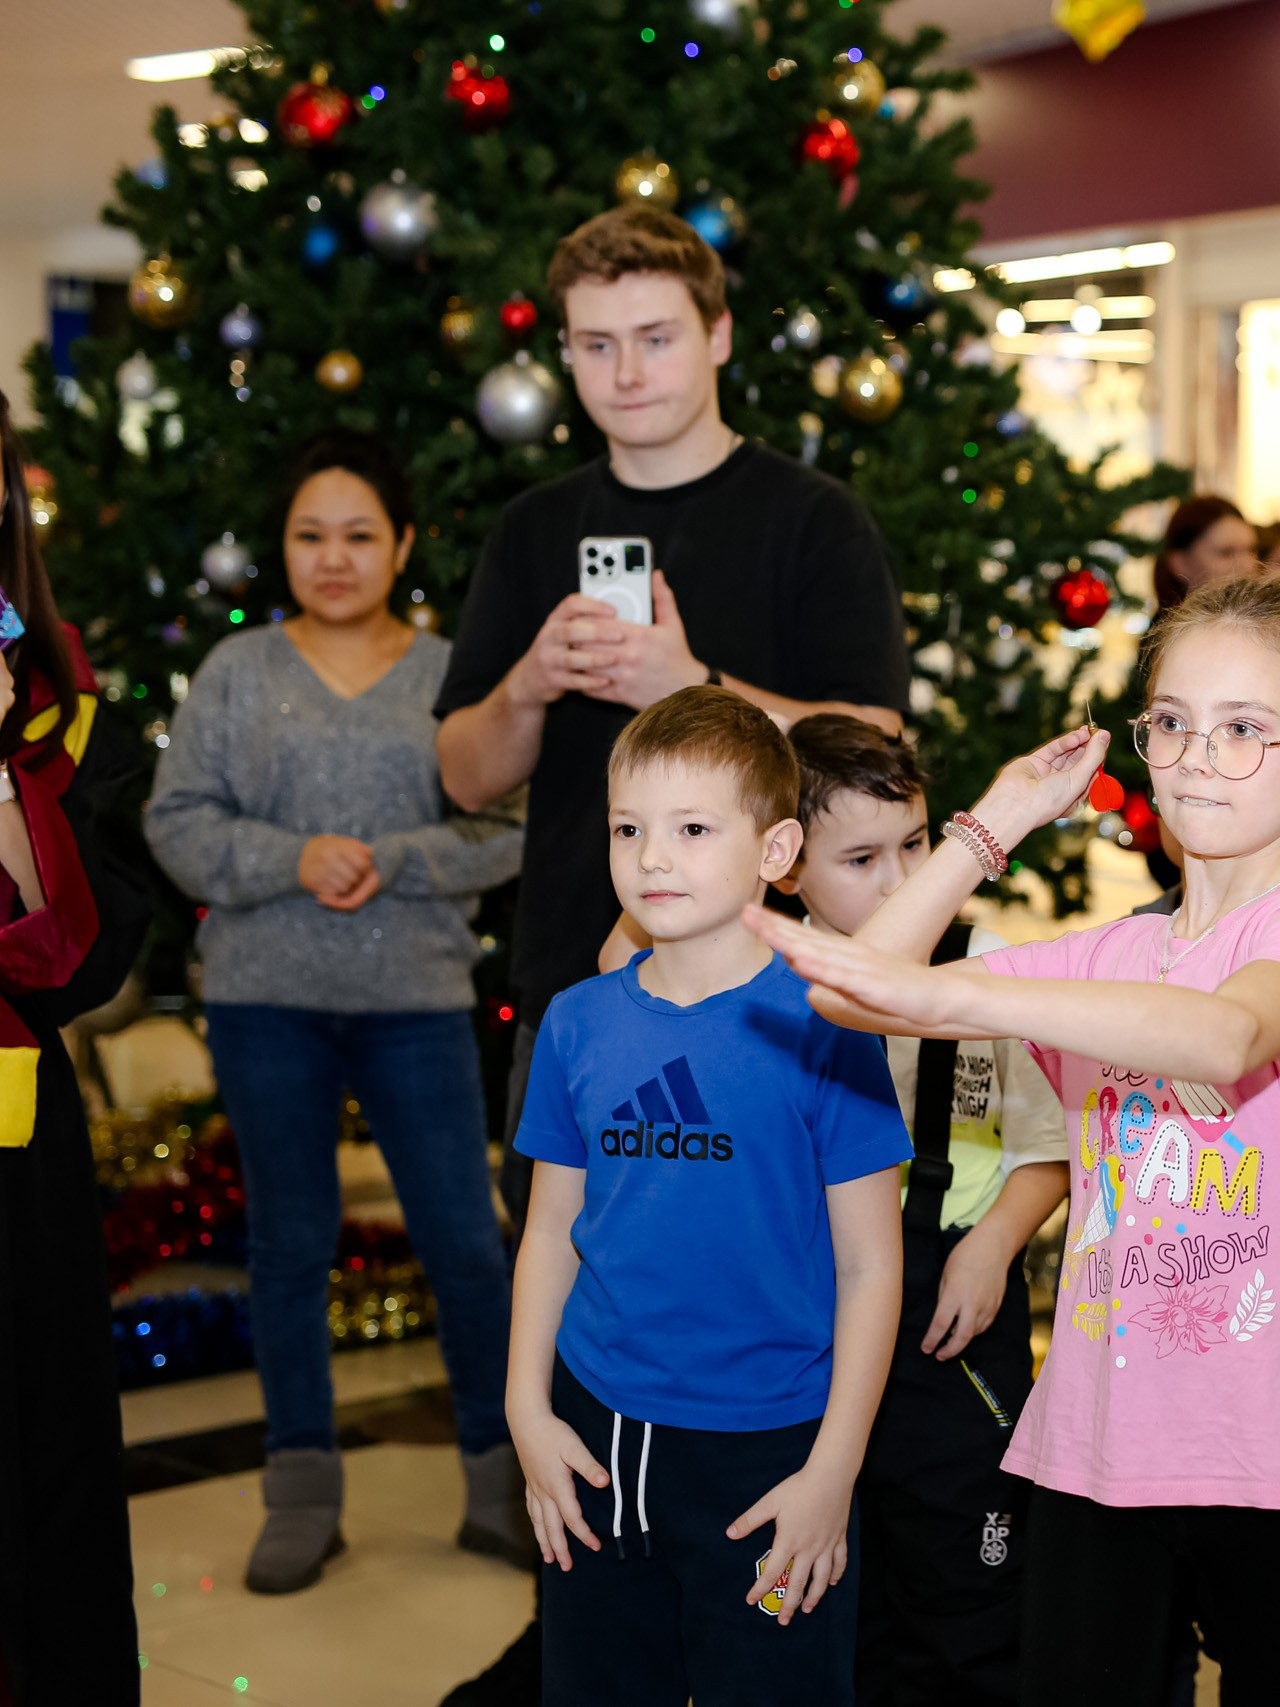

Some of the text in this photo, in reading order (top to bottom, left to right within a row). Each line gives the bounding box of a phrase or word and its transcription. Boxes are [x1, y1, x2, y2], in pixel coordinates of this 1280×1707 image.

[600, 1120, 733, 1162] adidas
[1120, 1245, 1149, 1288] A
[1153, 1225, 1270, 1288] SHOW
